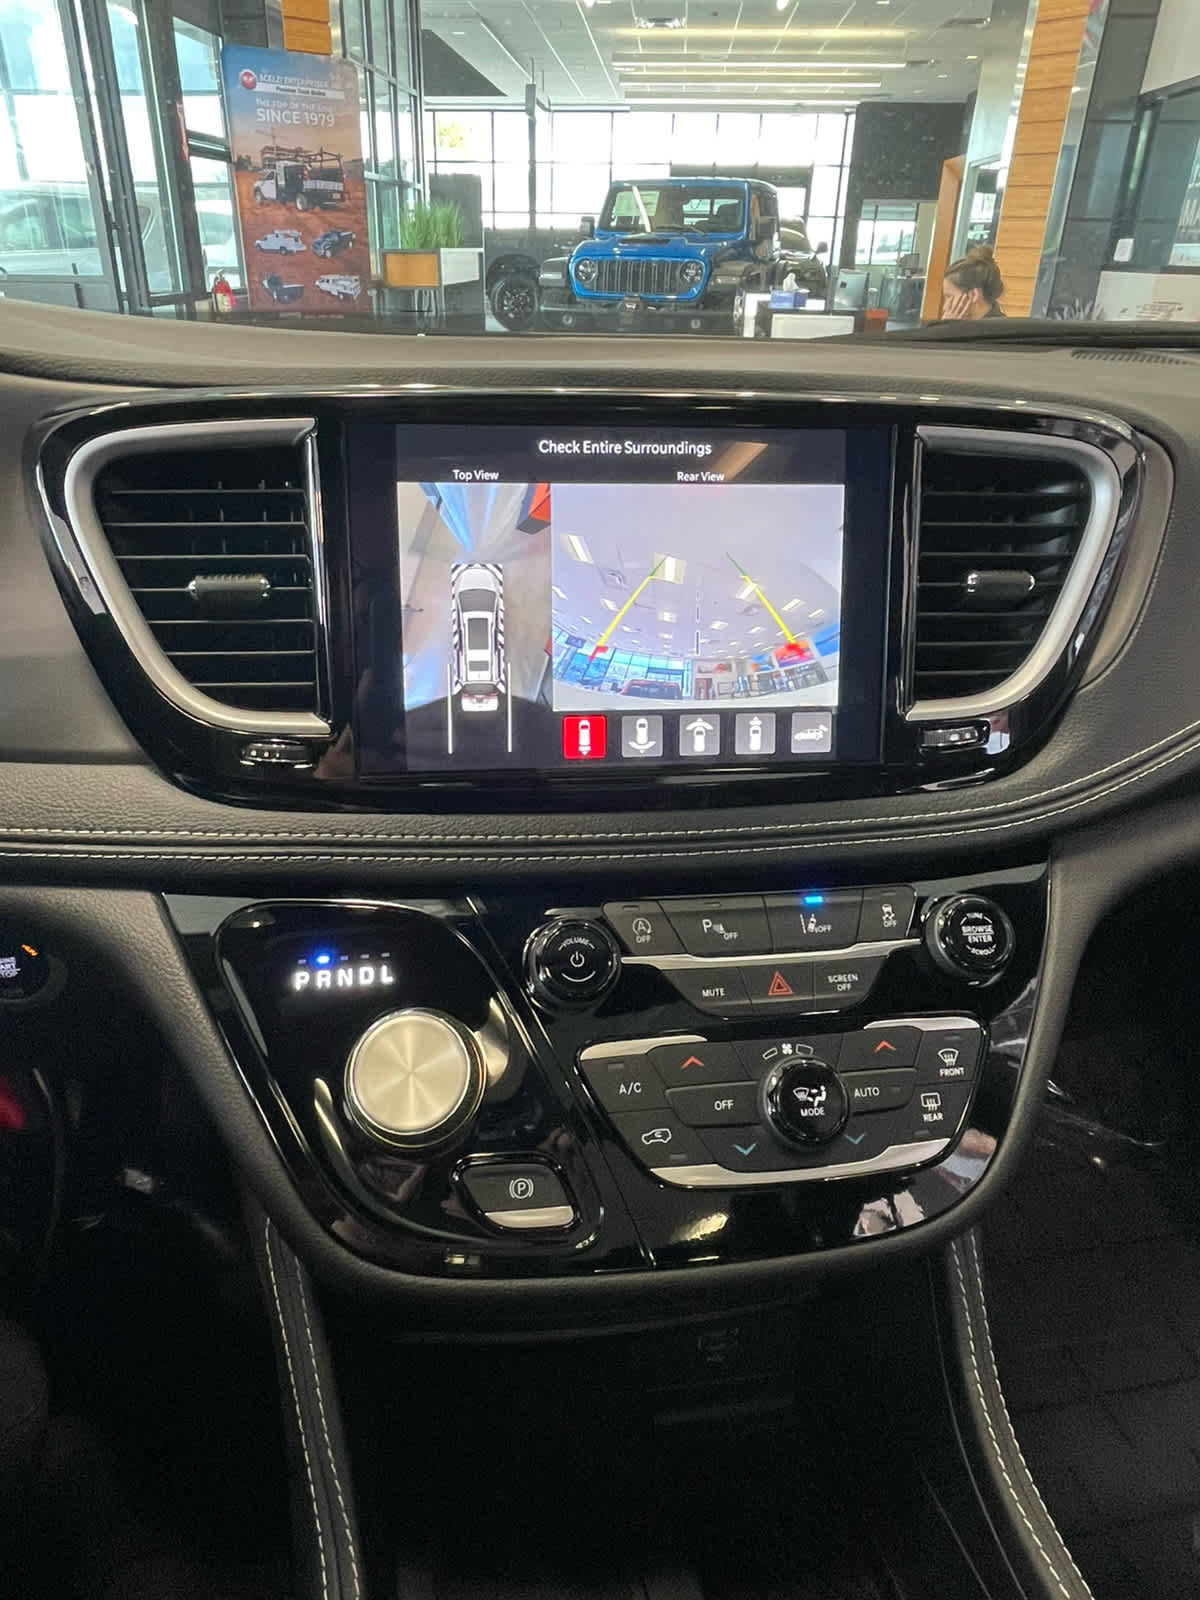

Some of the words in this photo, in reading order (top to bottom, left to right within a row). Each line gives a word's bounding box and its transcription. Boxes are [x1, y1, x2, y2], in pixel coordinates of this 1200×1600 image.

[256, 108, 300, 124] SINCE
[303, 112, 335, 127] 1979
[538, 439, 581, 455] Check
[582, 440, 622, 455] Entire
[624, 441, 712, 457] Surroundings
[452, 469, 472, 482] Top
[473, 469, 499, 481] View
[676, 471, 699, 482] Rear
[700, 471, 724, 482] View
[884, 919, 897, 928] OFF
[816, 924, 832, 934] OFF
[961, 924, 993, 934] BROWSE
[635, 935, 651, 944] OFF
[723, 931, 739, 941] OFF
[967, 934, 993, 944] ENTER
[562, 936, 590, 947] VOLUME
[969, 947, 994, 956] SCROLL
[828, 973, 859, 983] SCREEN
[837, 982, 852, 992] OFF
[702, 988, 725, 999] MUTE
[939, 1067, 965, 1077] FRONT
[619, 1081, 642, 1096] A/C
[854, 1087, 880, 1098] AUTO
[714, 1099, 734, 1111] OFF
[800, 1107, 825, 1117] MODE
[923, 1111, 944, 1122] REAR
